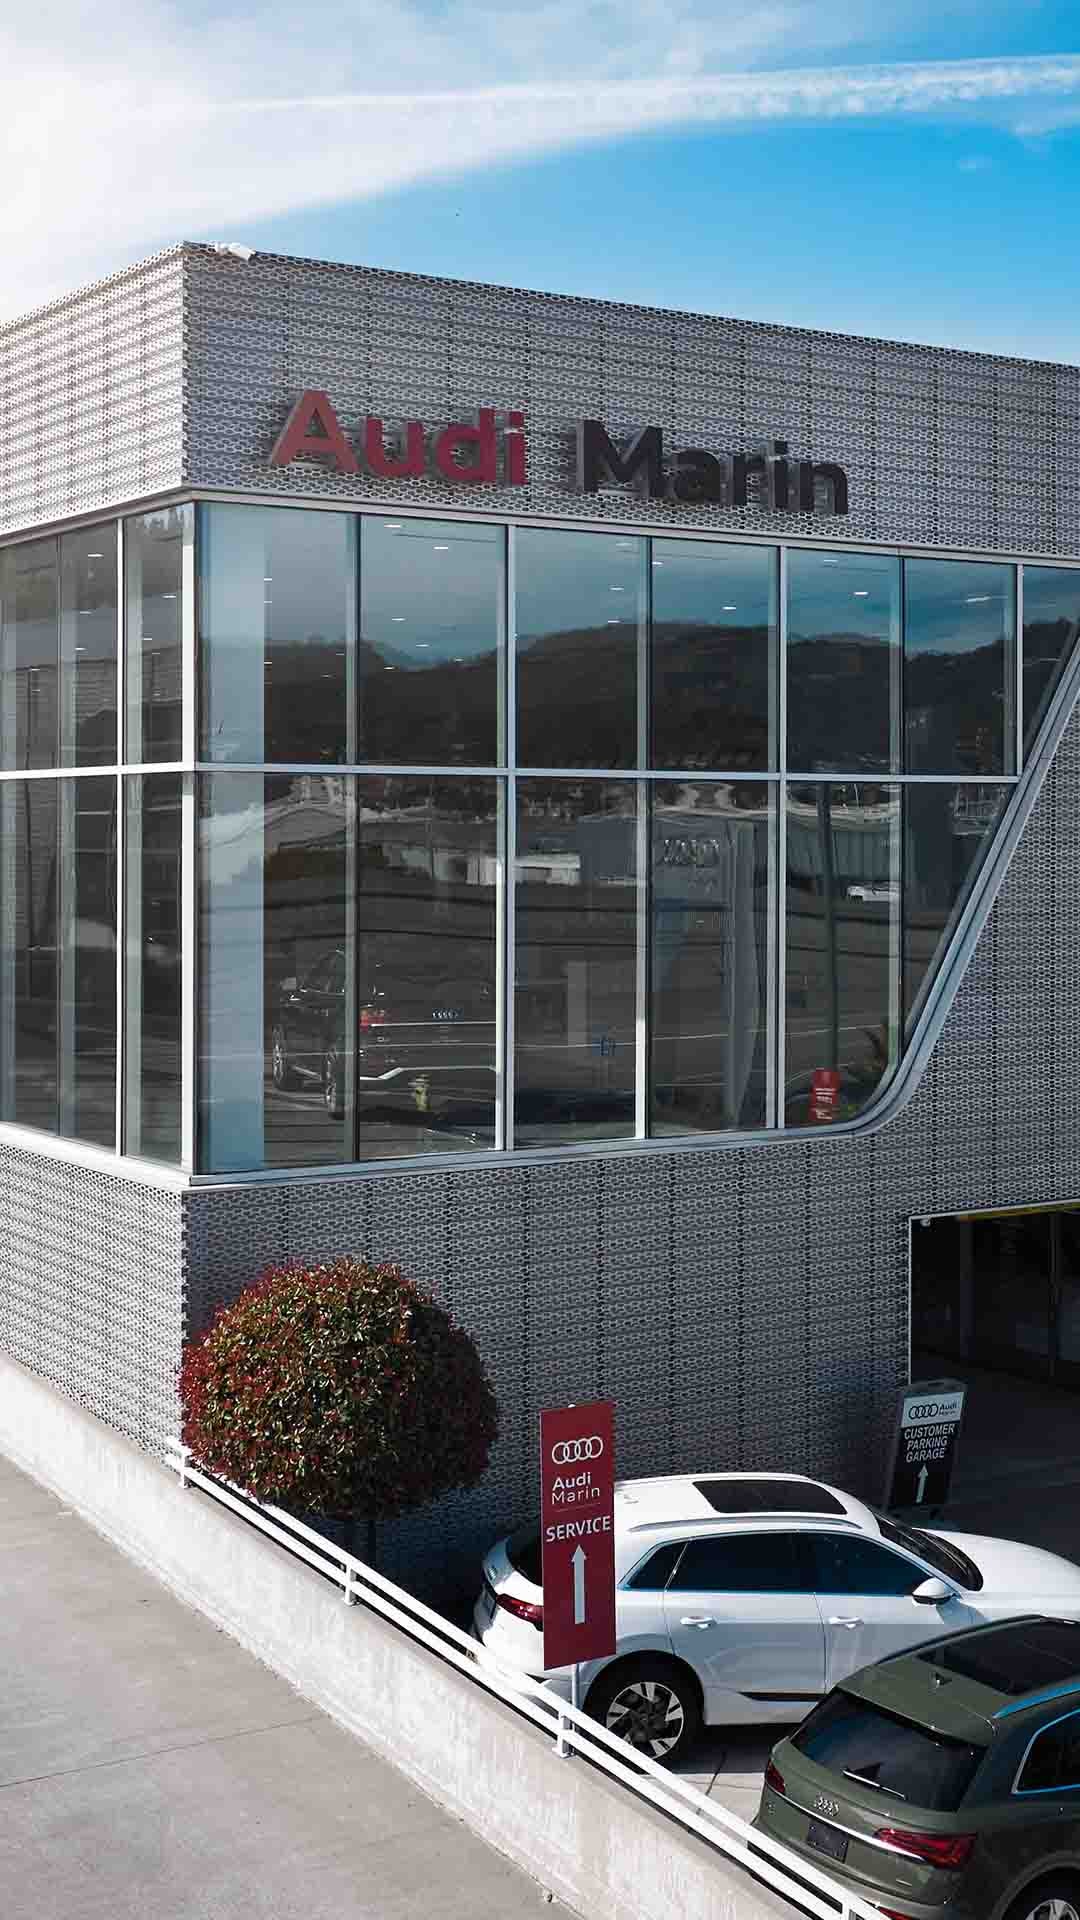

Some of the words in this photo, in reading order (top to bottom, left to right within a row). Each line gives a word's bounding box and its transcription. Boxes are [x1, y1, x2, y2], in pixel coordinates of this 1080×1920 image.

[270, 390, 528, 486] Audi
[576, 419, 848, 514] Marin
[904, 1424, 955, 1440] CUSTOMER
[907, 1436, 948, 1451] PARKING
[906, 1448, 945, 1463] GARAGE
[552, 1472, 591, 1491] Audi
[551, 1486, 600, 1504] Marin
[546, 1516, 611, 1542] SERVICE
